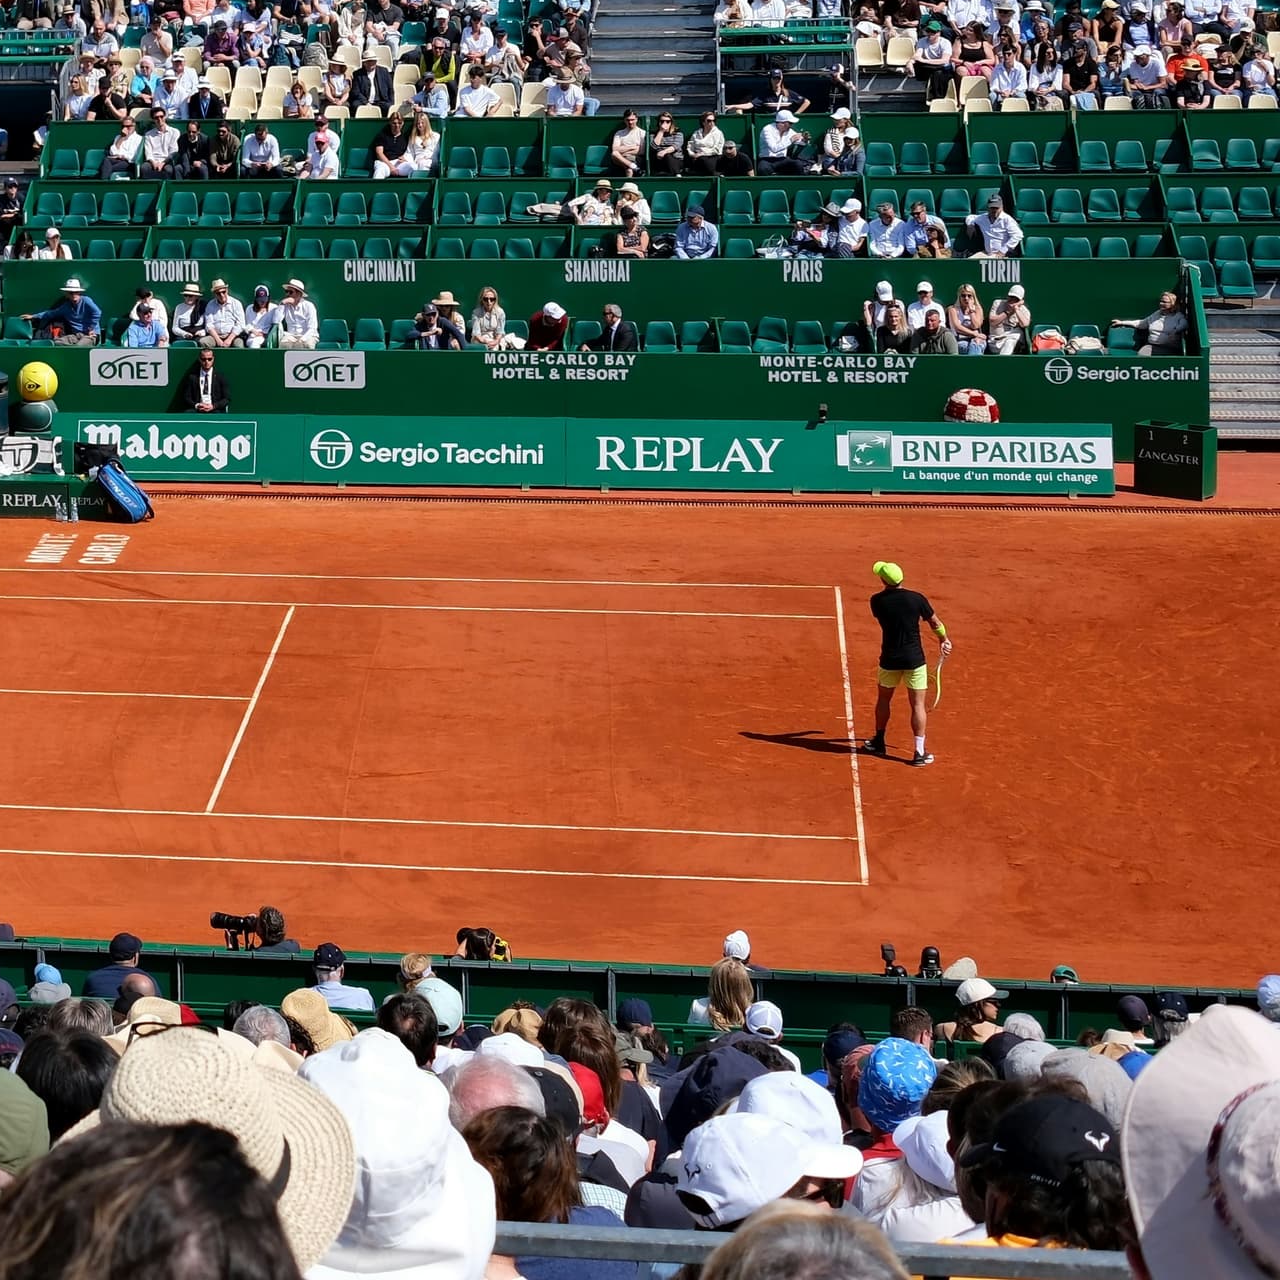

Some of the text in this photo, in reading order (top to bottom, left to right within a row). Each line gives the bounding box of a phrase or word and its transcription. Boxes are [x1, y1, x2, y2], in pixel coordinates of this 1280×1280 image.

[143, 260, 199, 282] TORONTO
[344, 260, 416, 282] CINCINNATI
[564, 260, 630, 282] SHANGHAI
[783, 260, 823, 283] PARIS
[980, 260, 1021, 283] TURIN
[484, 352, 636, 366] MONTE-CARLO BAY
[759, 356, 917, 369] MONTE-CARLO BAY
[492, 367, 628, 381] HOTEL & RESORT
[768, 370, 909, 384] HOTEL & RESORT
[1077, 366, 1200, 382] Sergio Tacchini
[84, 423, 251, 470] Malongo
[359, 442, 544, 467] Sergio Tacchini
[595, 435, 785, 473] REPLAY
[902, 440, 1097, 464] BNP PARIBAS
[1138, 447, 1200, 466] LANCASTER
[902, 470, 1099, 485] La banque d'un monde qui change
[2, 493, 63, 508] REPLAY
